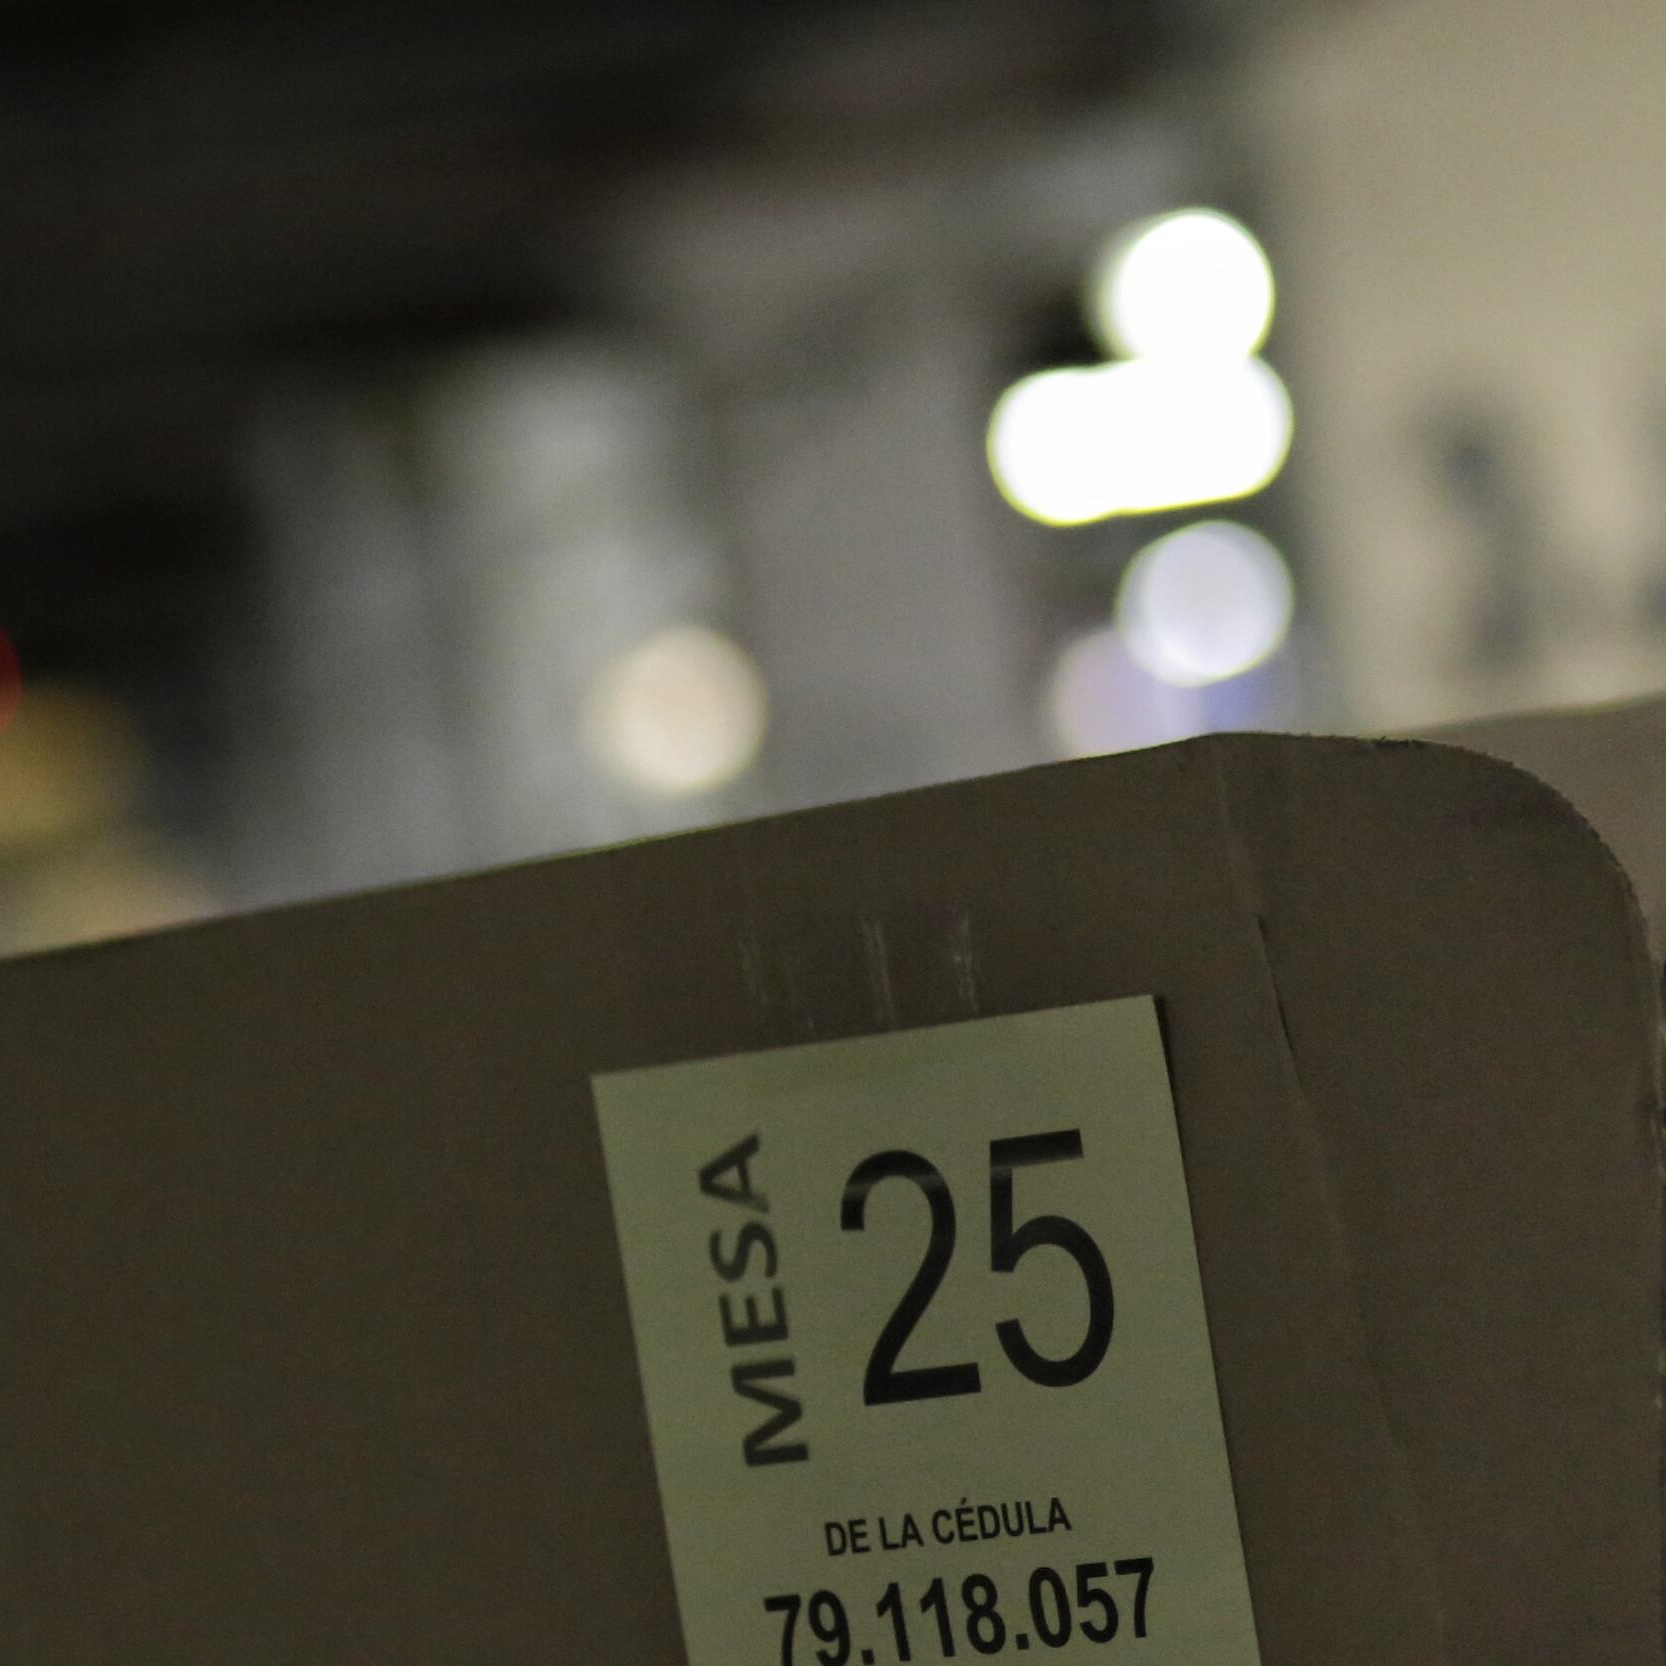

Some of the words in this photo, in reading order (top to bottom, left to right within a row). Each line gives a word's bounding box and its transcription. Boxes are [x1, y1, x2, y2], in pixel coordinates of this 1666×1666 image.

[698, 1132, 808, 1467] MESA
[840, 1129, 1114, 1406] 25
[825, 1518, 870, 1556] DE
[878, 1513, 924, 1549] LA
[932, 1498, 1072, 1545] CÉDULA
